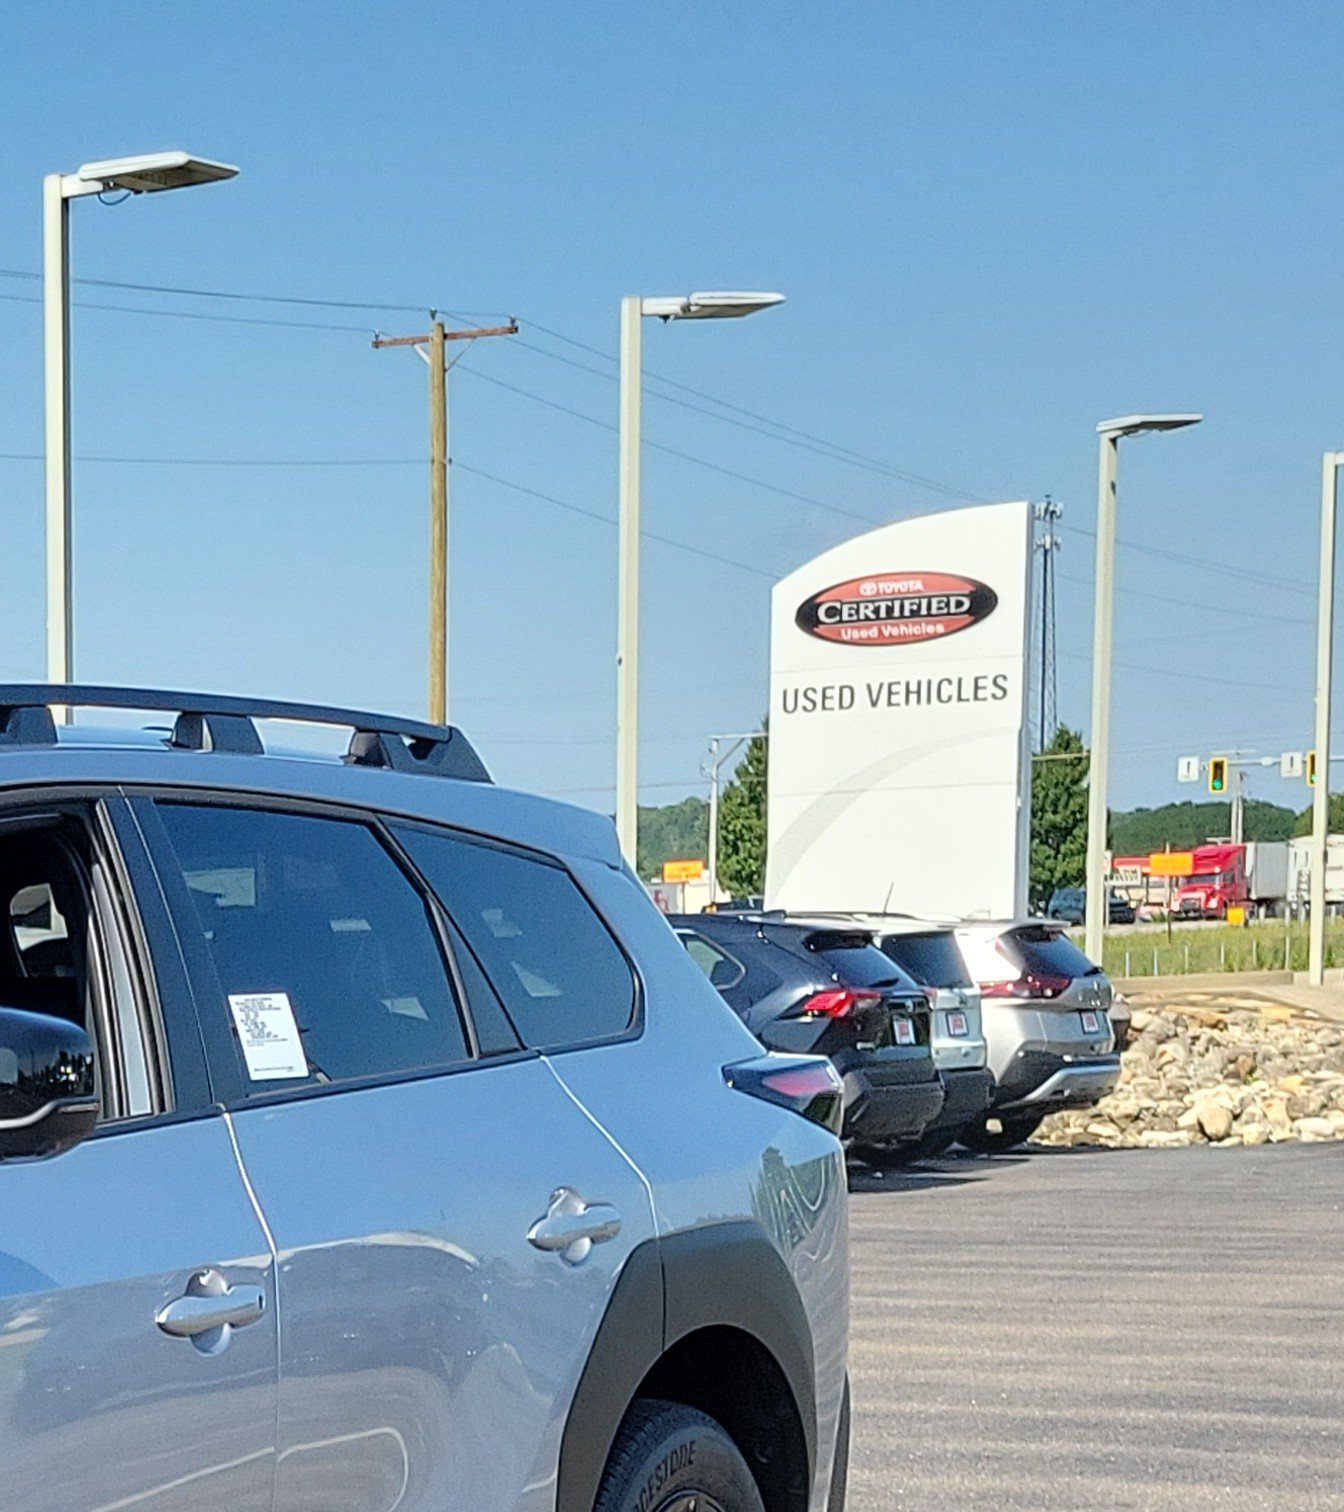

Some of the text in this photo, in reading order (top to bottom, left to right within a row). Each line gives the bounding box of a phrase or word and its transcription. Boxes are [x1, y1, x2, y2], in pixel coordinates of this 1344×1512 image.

[879, 580, 924, 592] TOYOTA
[817, 596, 971, 623] CERTIFIED
[841, 623, 945, 640] Used Vehicles
[782, 674, 1009, 714] USED VEHICLES
